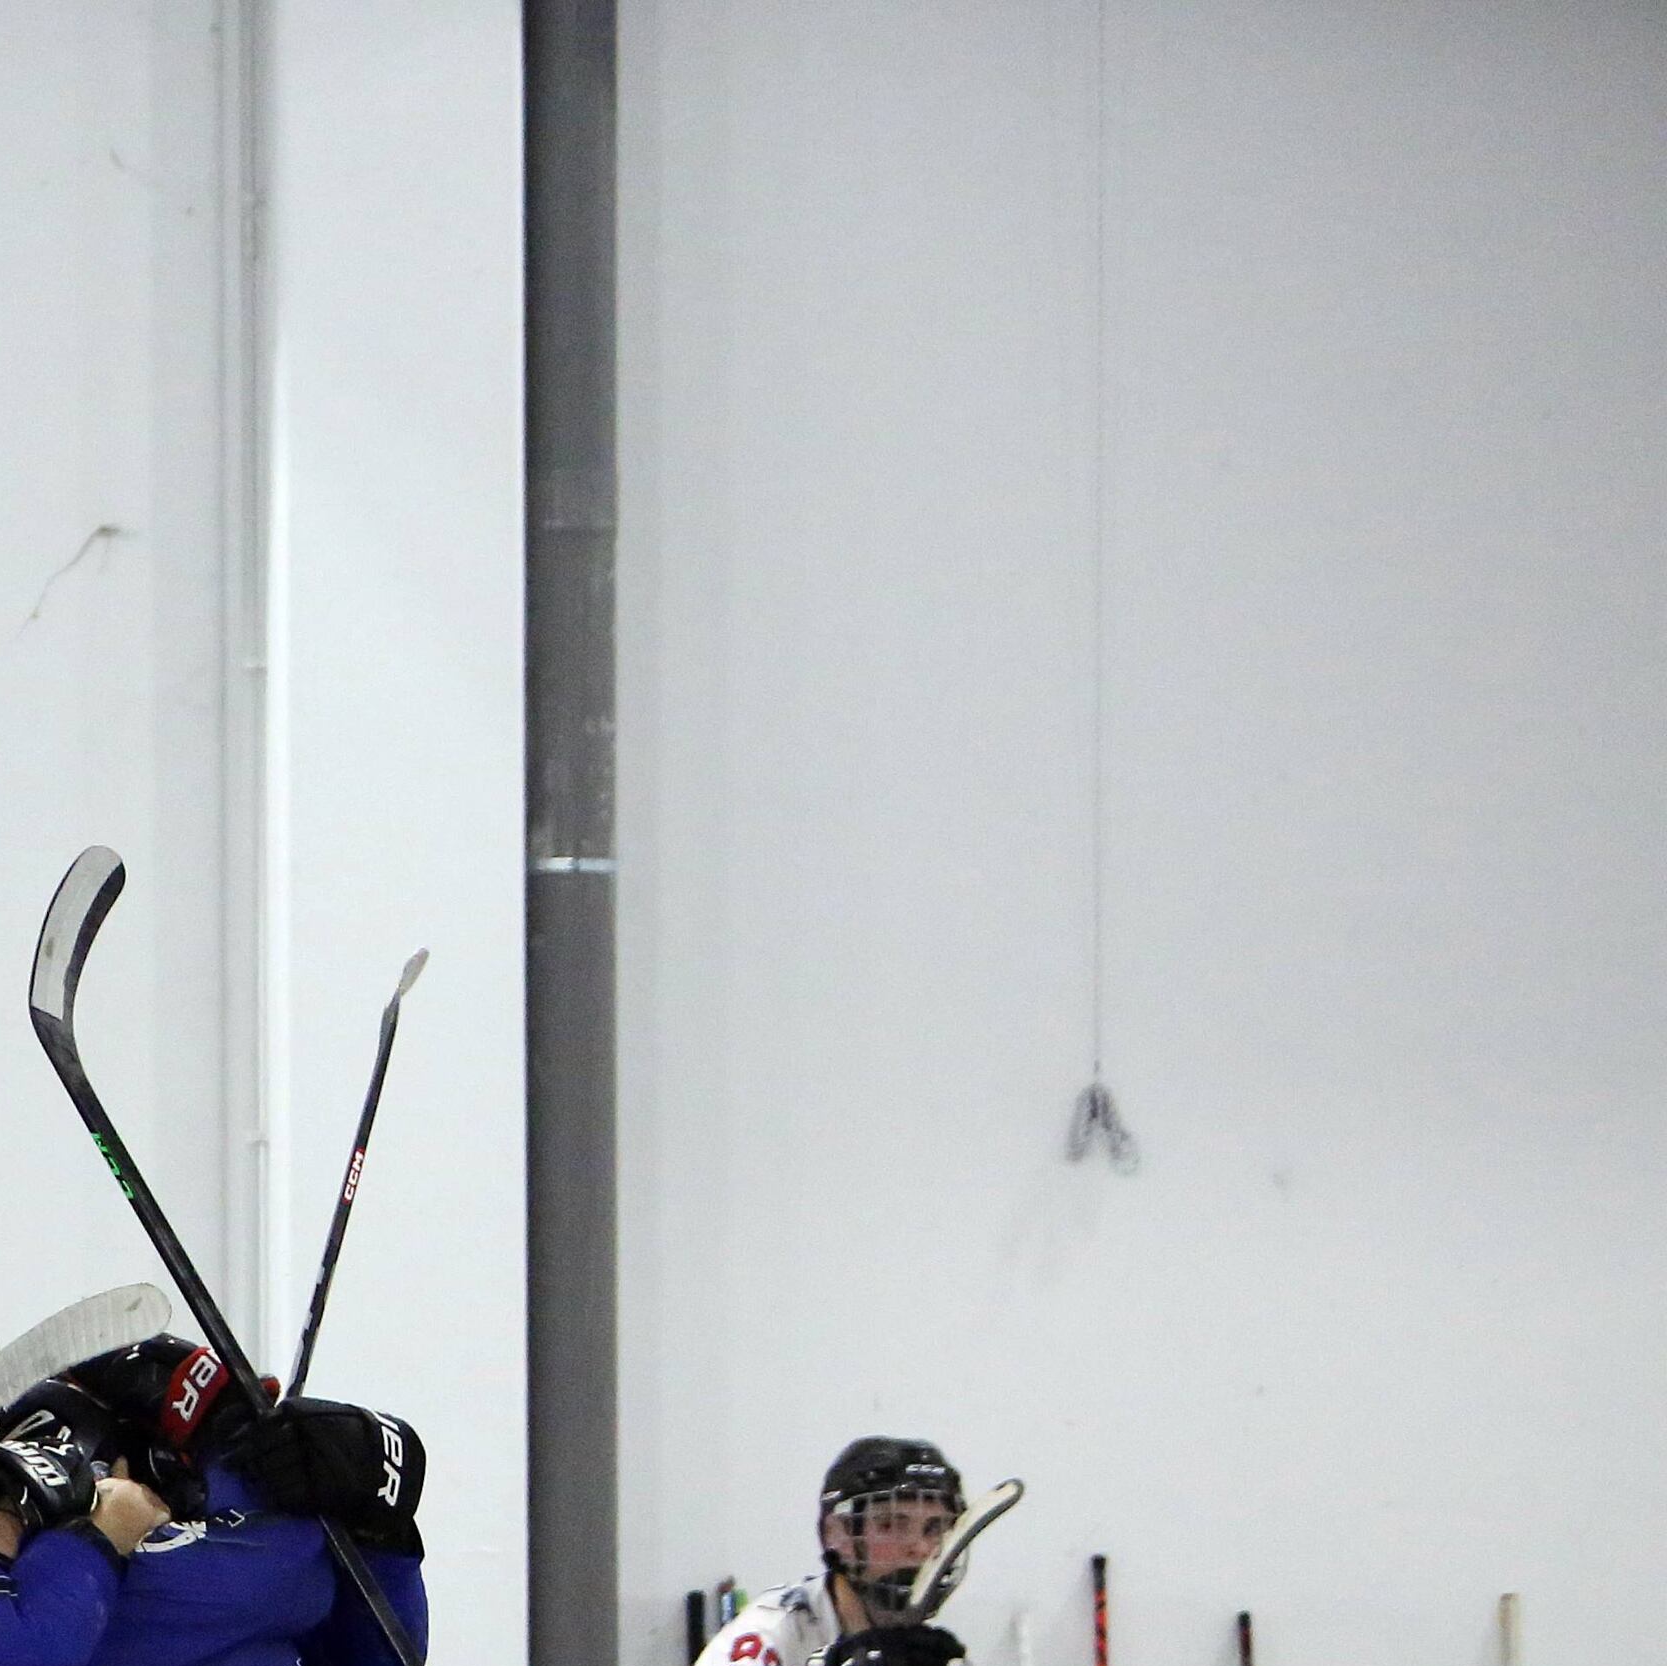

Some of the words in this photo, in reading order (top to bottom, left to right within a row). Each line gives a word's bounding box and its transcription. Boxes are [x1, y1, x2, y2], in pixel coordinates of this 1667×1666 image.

[343, 1150, 365, 1201] CCM
[171, 1351, 223, 1422] ER
[373, 1409, 404, 1507] ER
